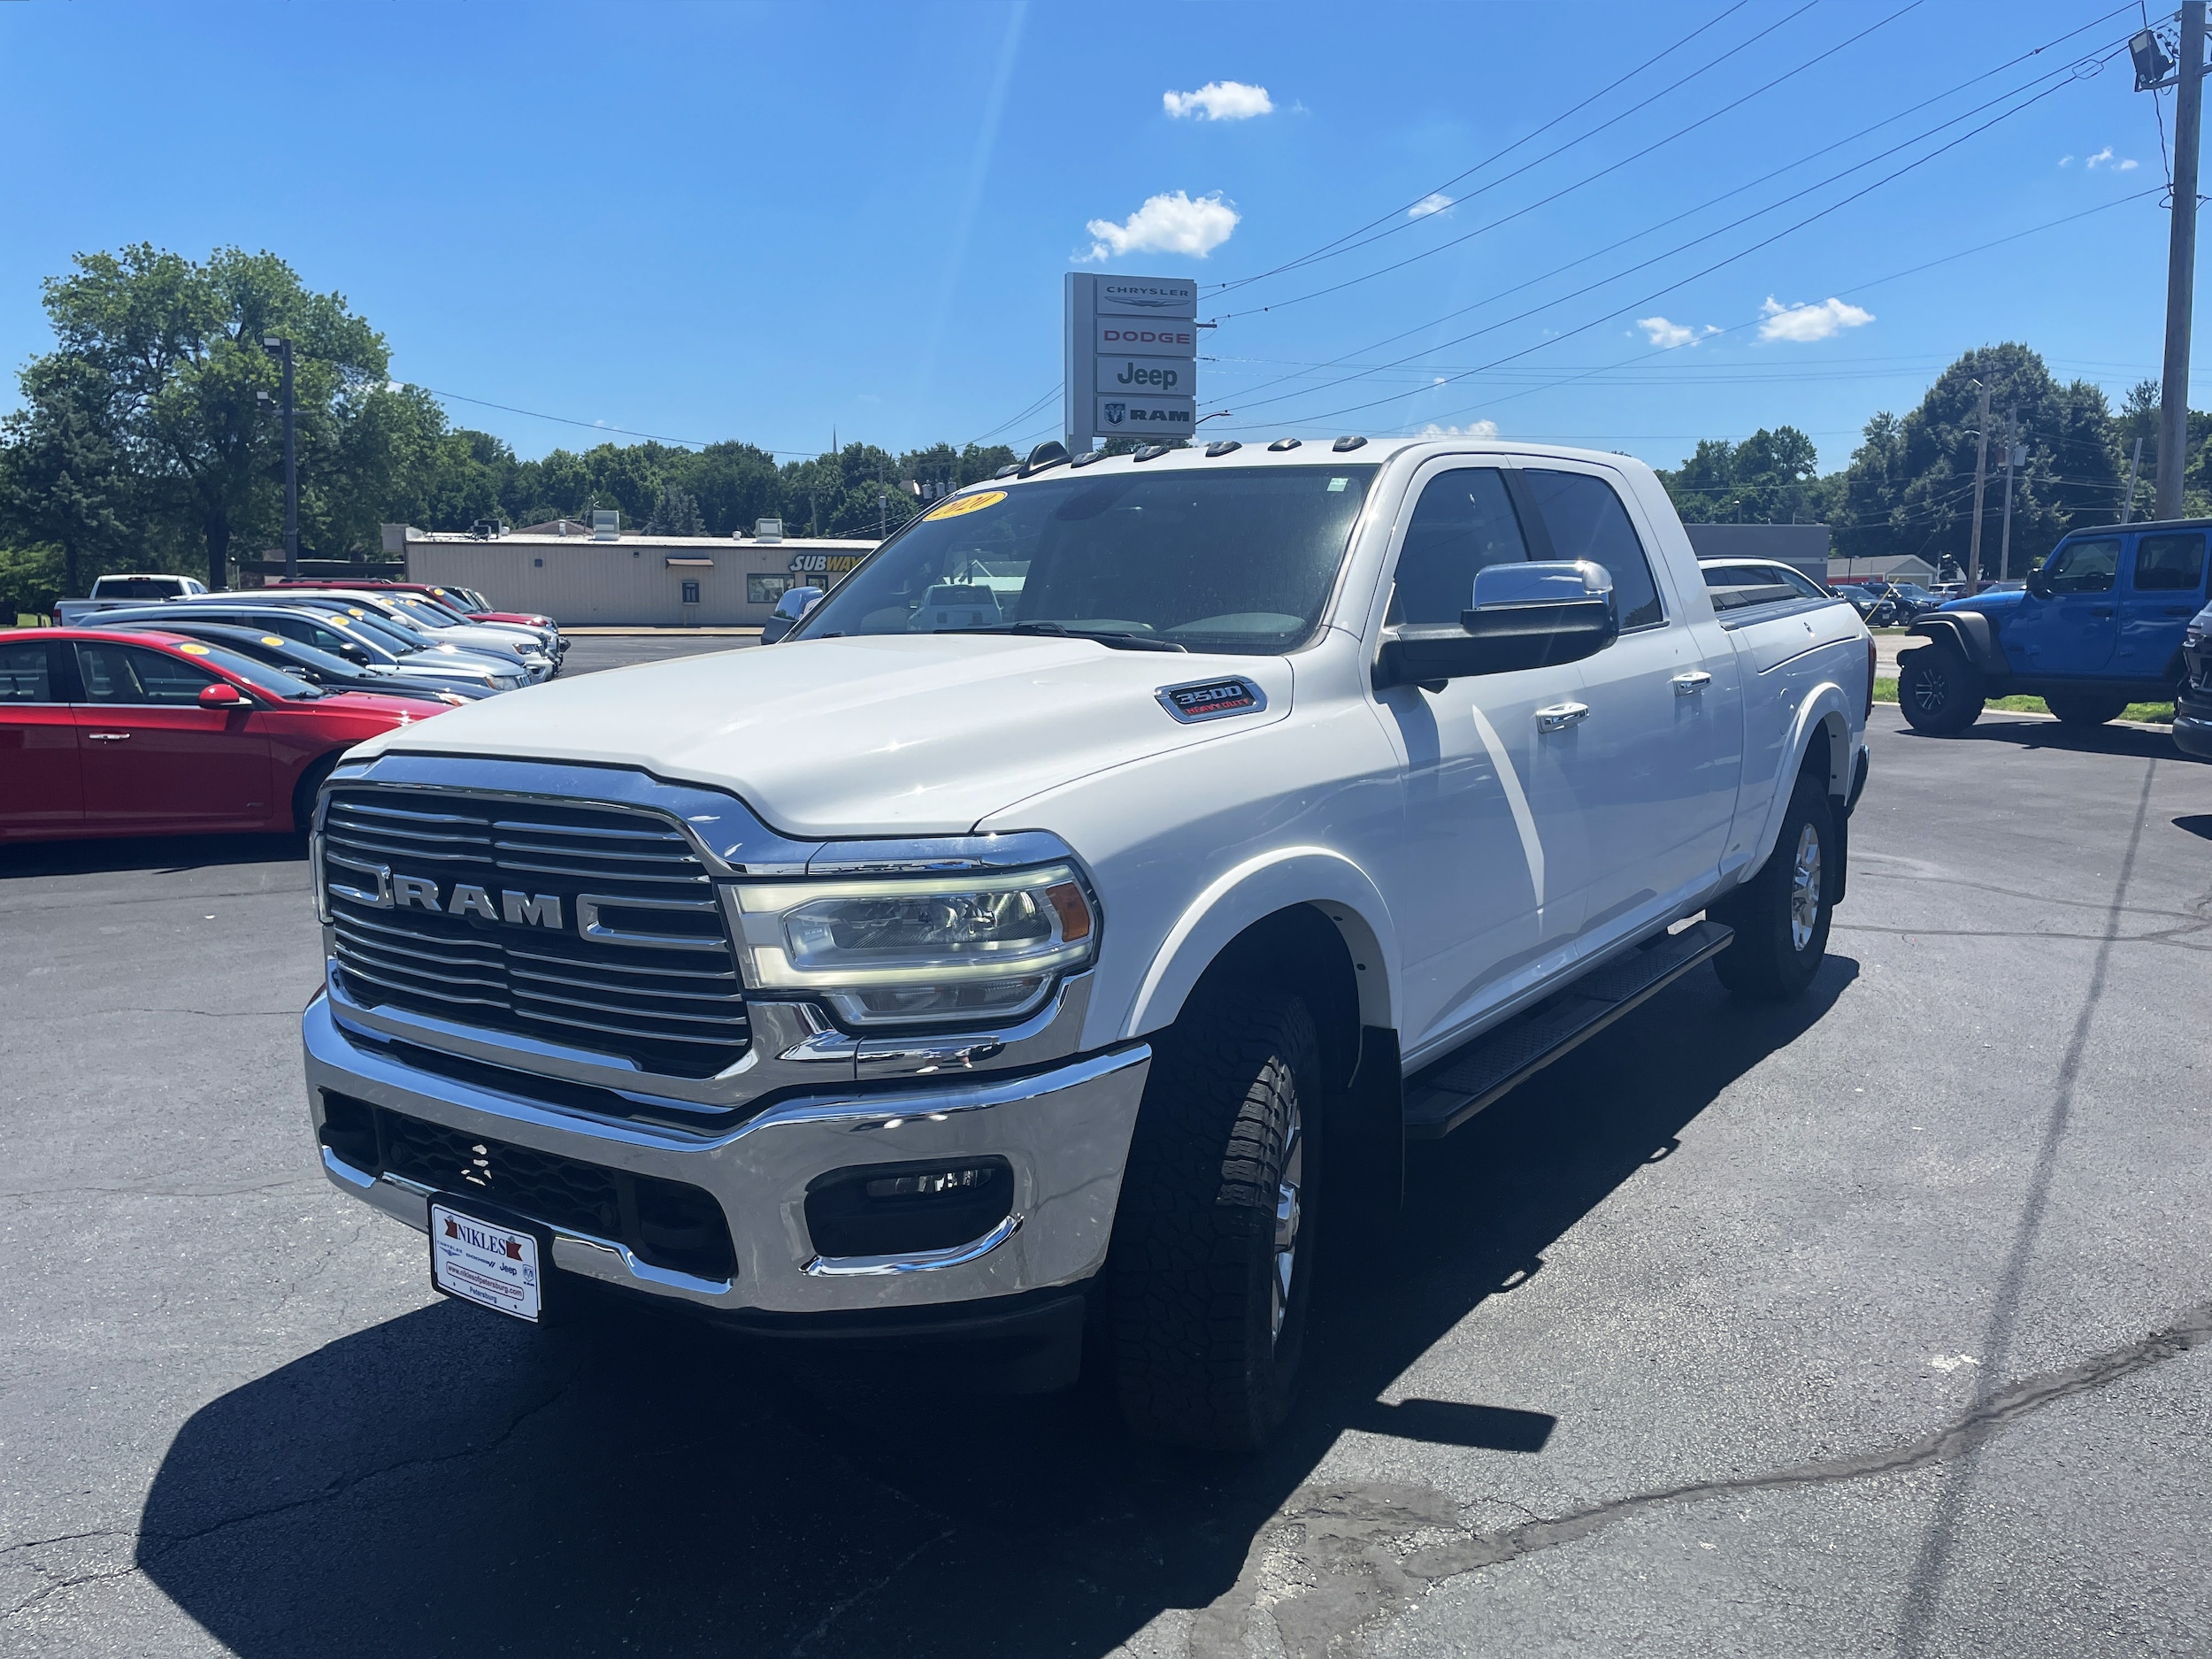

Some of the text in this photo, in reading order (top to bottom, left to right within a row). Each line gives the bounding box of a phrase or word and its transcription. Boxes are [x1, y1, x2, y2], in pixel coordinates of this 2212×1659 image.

[1106, 286, 1189, 296] CHRYSLER
[1103, 330, 1190, 344] DODGE
[1118, 362, 1178, 390] Jeep
[1130, 409, 1190, 422] RAM
[789, 555, 865, 572] SUBWAY
[1175, 685, 1243, 705] 3500
[1186, 697, 1249, 715] HEAVY DUTY
[392, 872, 564, 930] RAM
[457, 1224, 506, 1256] NIKLES
[499, 1262, 518, 1277] Jeep
[448, 1263, 523, 1298] www.niklesofpetersburg.com
[469, 1286, 497, 1304] Petersburg
